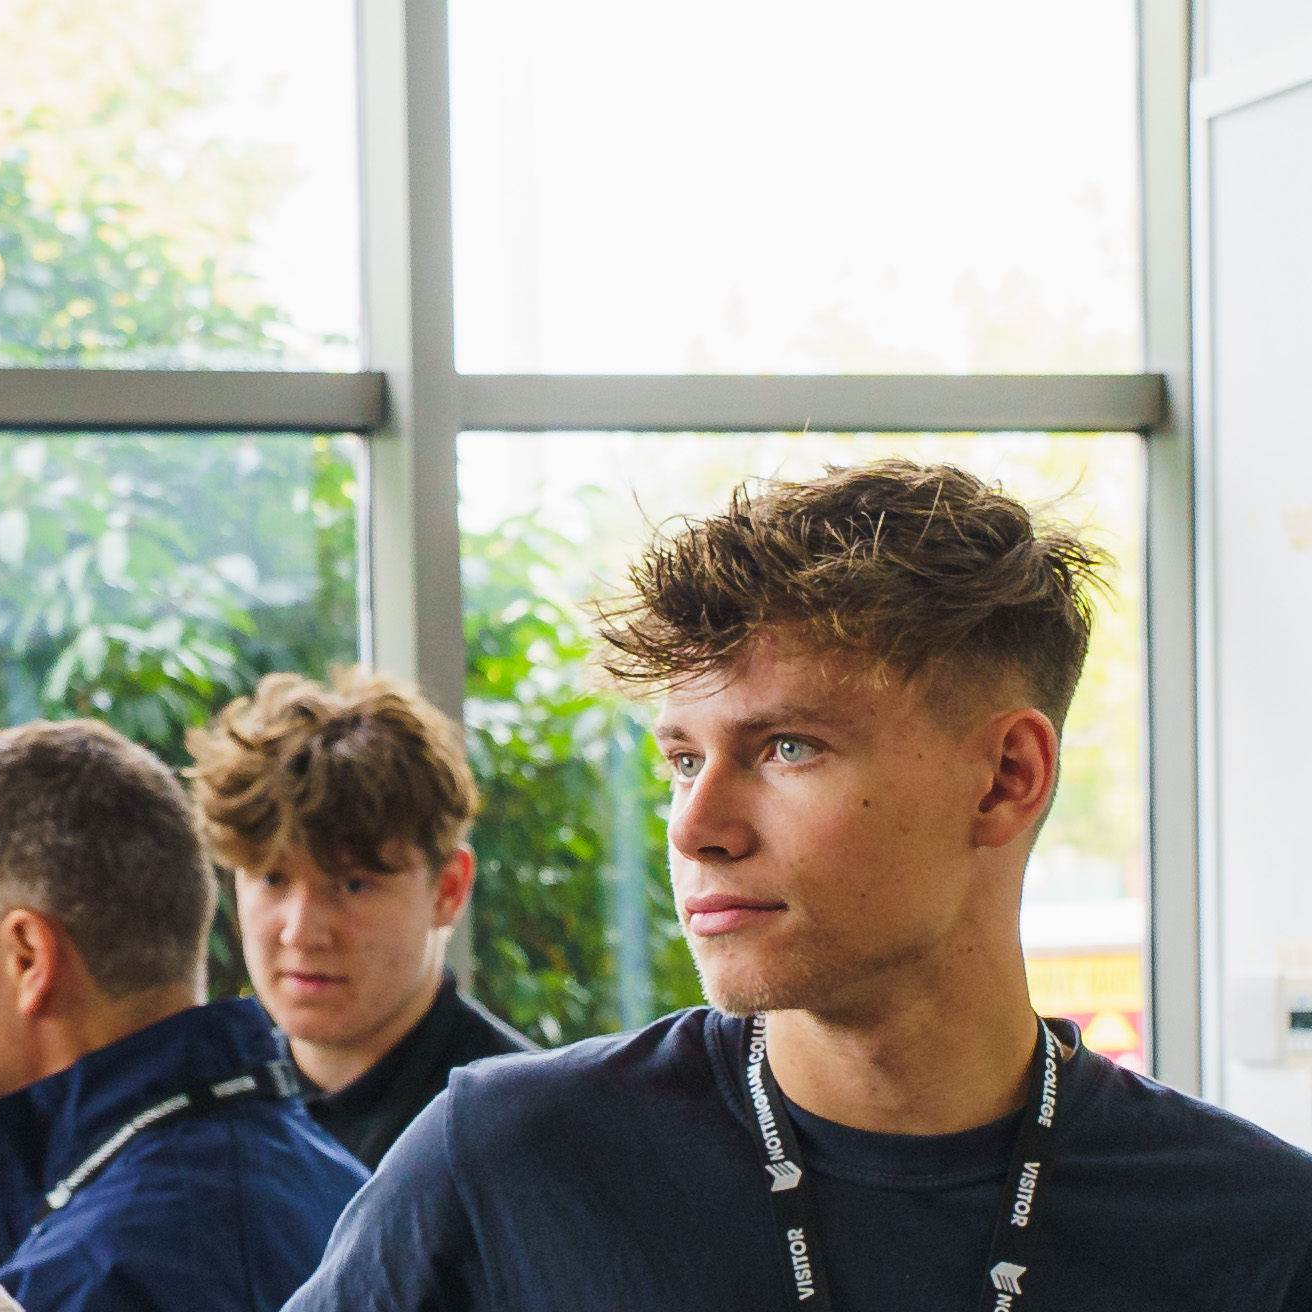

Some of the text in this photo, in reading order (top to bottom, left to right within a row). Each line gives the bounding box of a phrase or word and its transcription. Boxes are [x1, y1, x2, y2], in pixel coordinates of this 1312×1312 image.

[746, 1063, 785, 1160] NOTTINGHAM
[1038, 1057, 1057, 1128] COLLEGE
[1011, 1162, 1040, 1228] VISITOR
[787, 1228, 815, 1301] VISITOR
